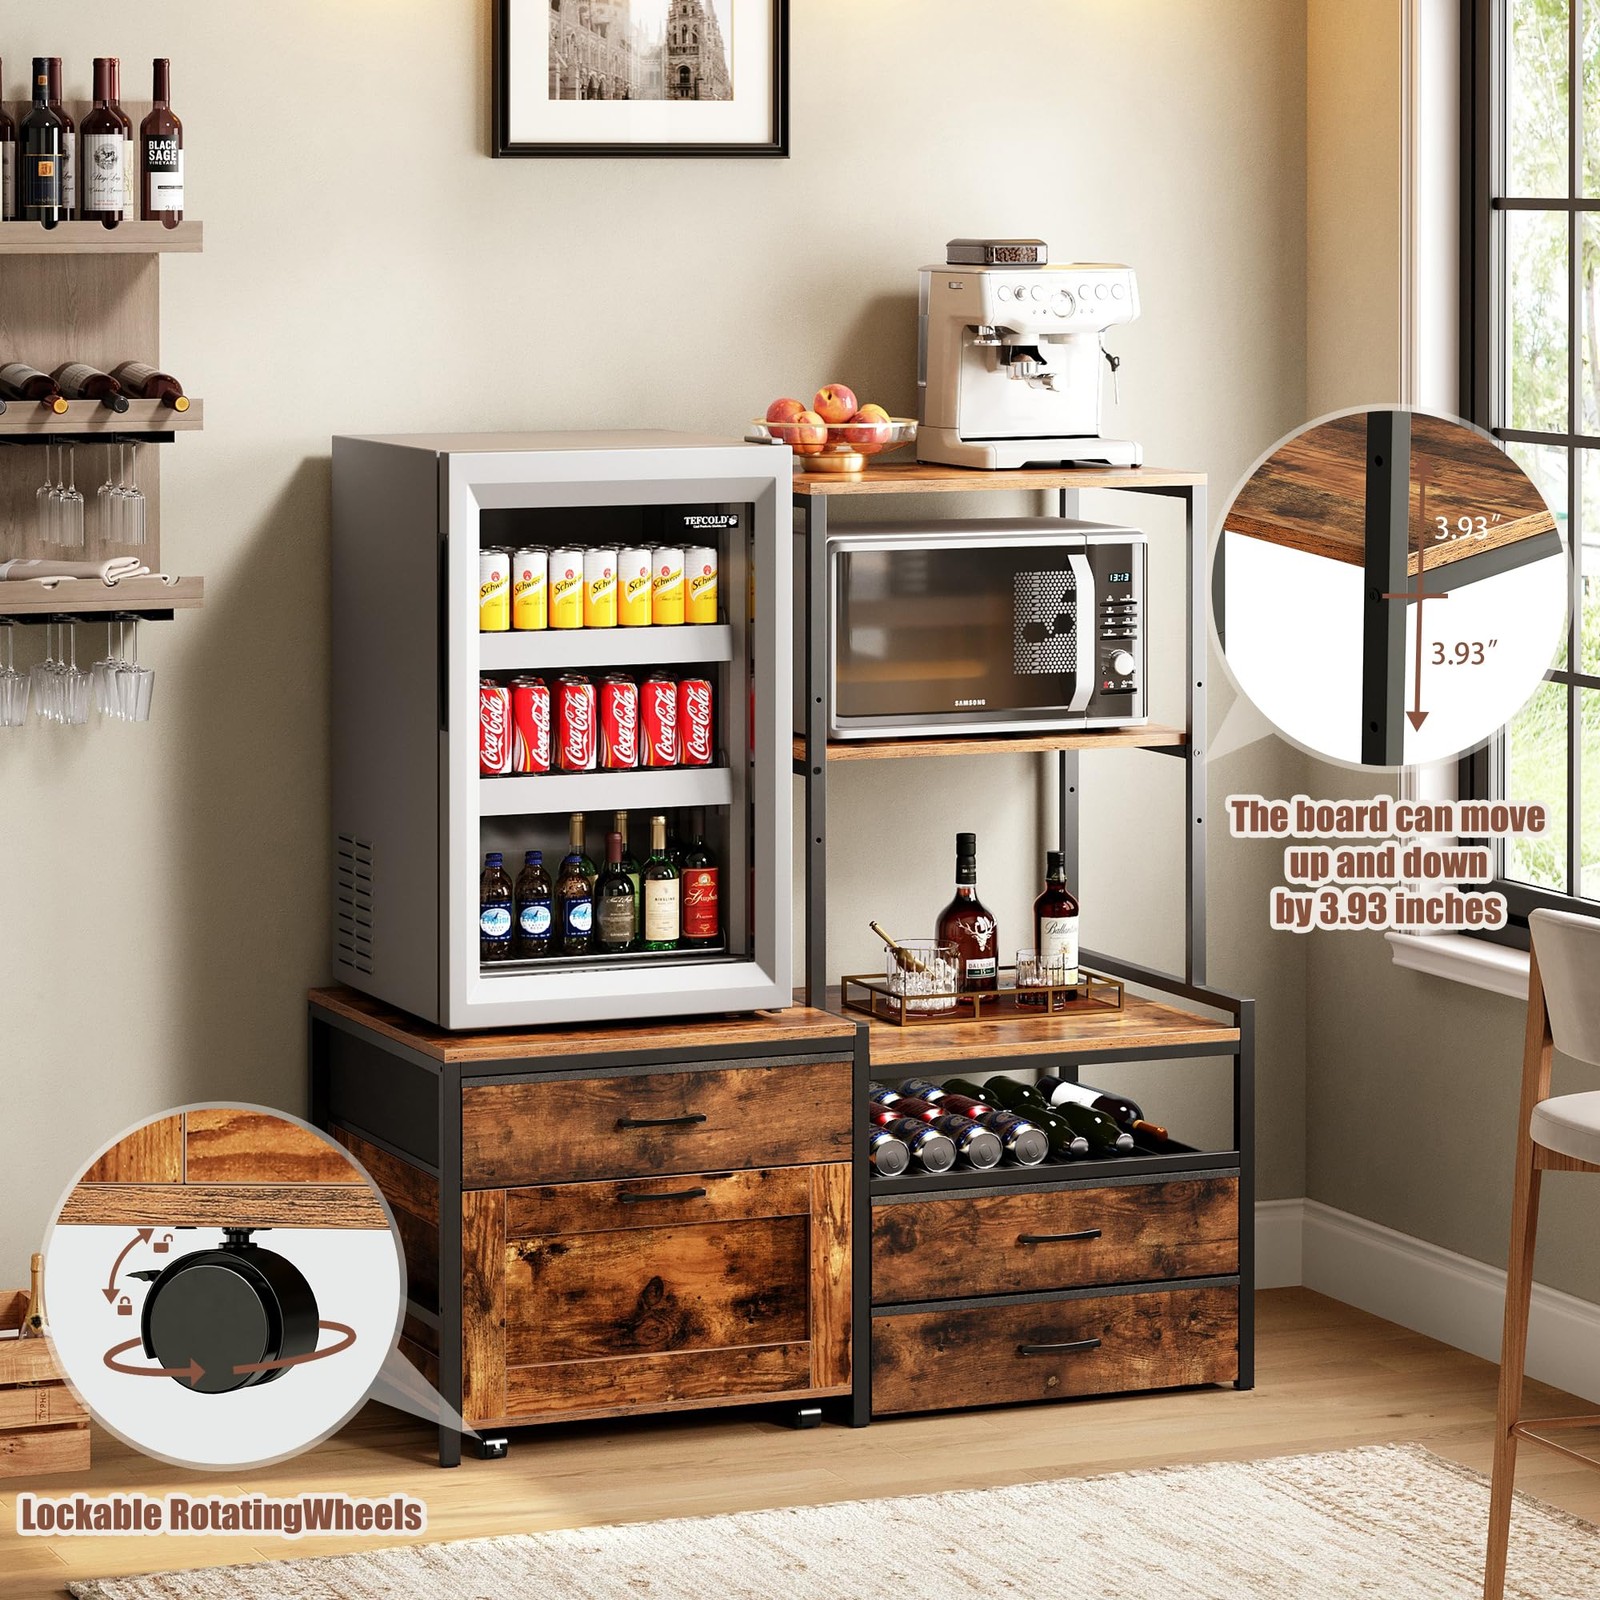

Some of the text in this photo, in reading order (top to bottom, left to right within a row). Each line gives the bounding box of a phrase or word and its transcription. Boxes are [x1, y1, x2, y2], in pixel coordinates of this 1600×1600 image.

[149, 141, 177, 150] BLACK
[149, 150, 177, 161] SAGE
[684, 516, 728, 525] TEFCOLD
[1109, 573, 1130, 582] 13:13
[955, 699, 986, 707] SAMSUNG
